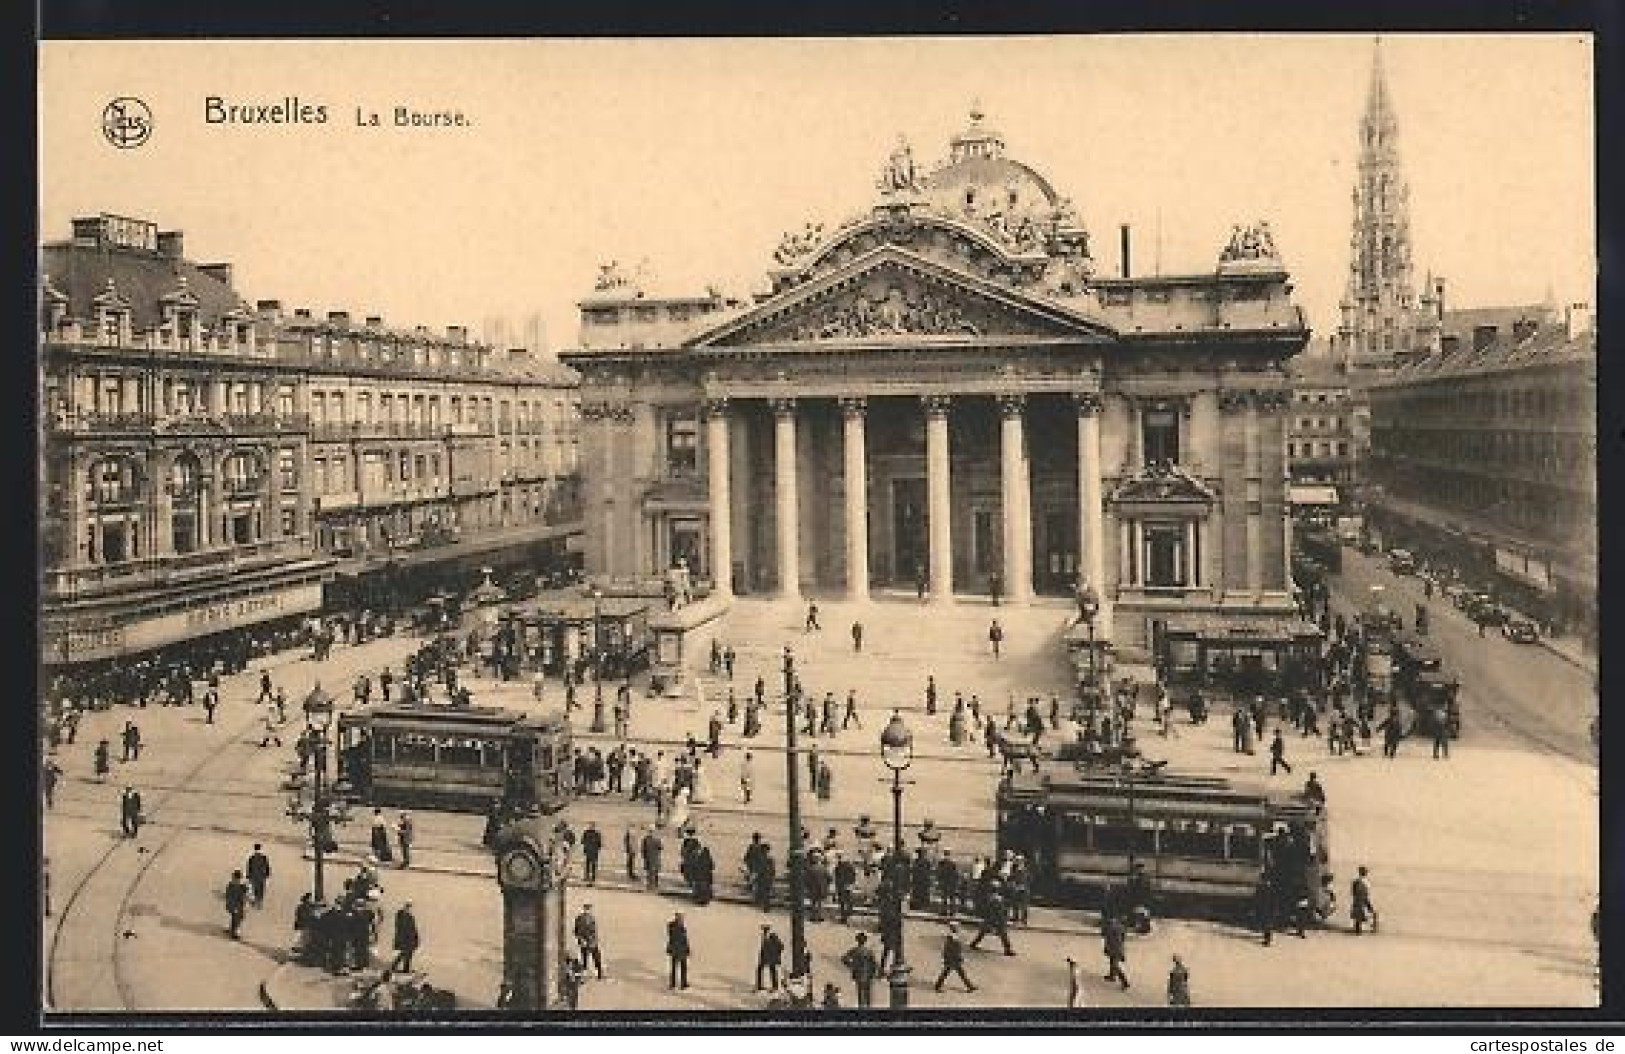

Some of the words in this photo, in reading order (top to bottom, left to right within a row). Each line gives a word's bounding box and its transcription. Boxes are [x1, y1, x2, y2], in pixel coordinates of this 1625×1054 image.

[205, 96, 329, 124] Bruxelles
[356, 106, 380, 127] La
[394, 106, 471, 127] Bourse.
